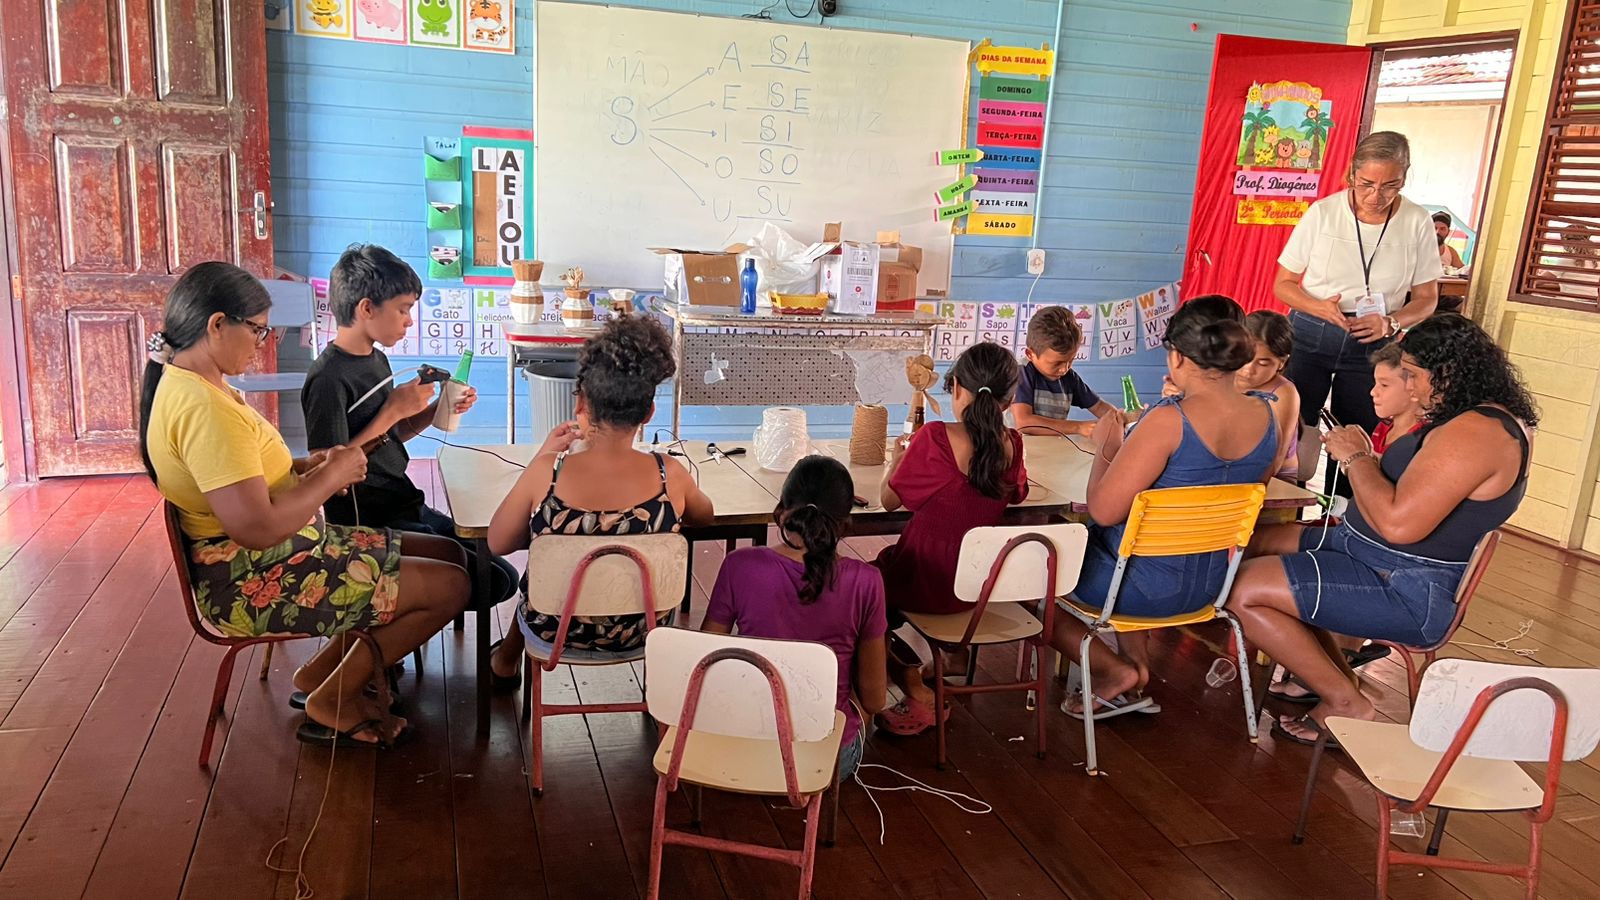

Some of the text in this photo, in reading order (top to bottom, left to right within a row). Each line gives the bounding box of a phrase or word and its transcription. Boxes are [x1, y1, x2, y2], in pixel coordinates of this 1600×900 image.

[718, 41, 741, 72] A
[981, 54, 1000, 62] DIAS
[1014, 56, 1047, 65] SEMANA
[996, 86, 1032, 95] DOMINGO
[723, 84, 742, 111] E
[981, 107, 1043, 118] SEGUNDA-FEIRA
[610, 95, 638, 146] S
[985, 131, 1037, 141] TERÇA-FEIRA
[477, 149, 490, 170] L
[947, 153, 970, 161] ONTEM
[983, 153, 1036, 163] UARTA-FEIRA
[950, 183, 965, 194] HOJE
[1236, 174, 1317, 193] Prof. Diogênes
[984, 220, 1017, 229] SÁBADO
[477, 291, 494, 307] H
[1138, 292, 1155, 310] W
[432, 308, 459, 320] Gato
[941, 303, 955, 318] R
[981, 303, 995, 318] S
[1099, 302, 1114, 318] V
[947, 319, 967, 329] Rato
[986, 320, 1008, 331] Sapo
[1106, 318, 1128, 327] Vaca
[1145, 320, 1157, 334] W
[427, 322, 464, 338] G g
[481, 323, 493, 339] H
[1104, 330, 1114, 343] V
[942, 332, 952, 345] R
